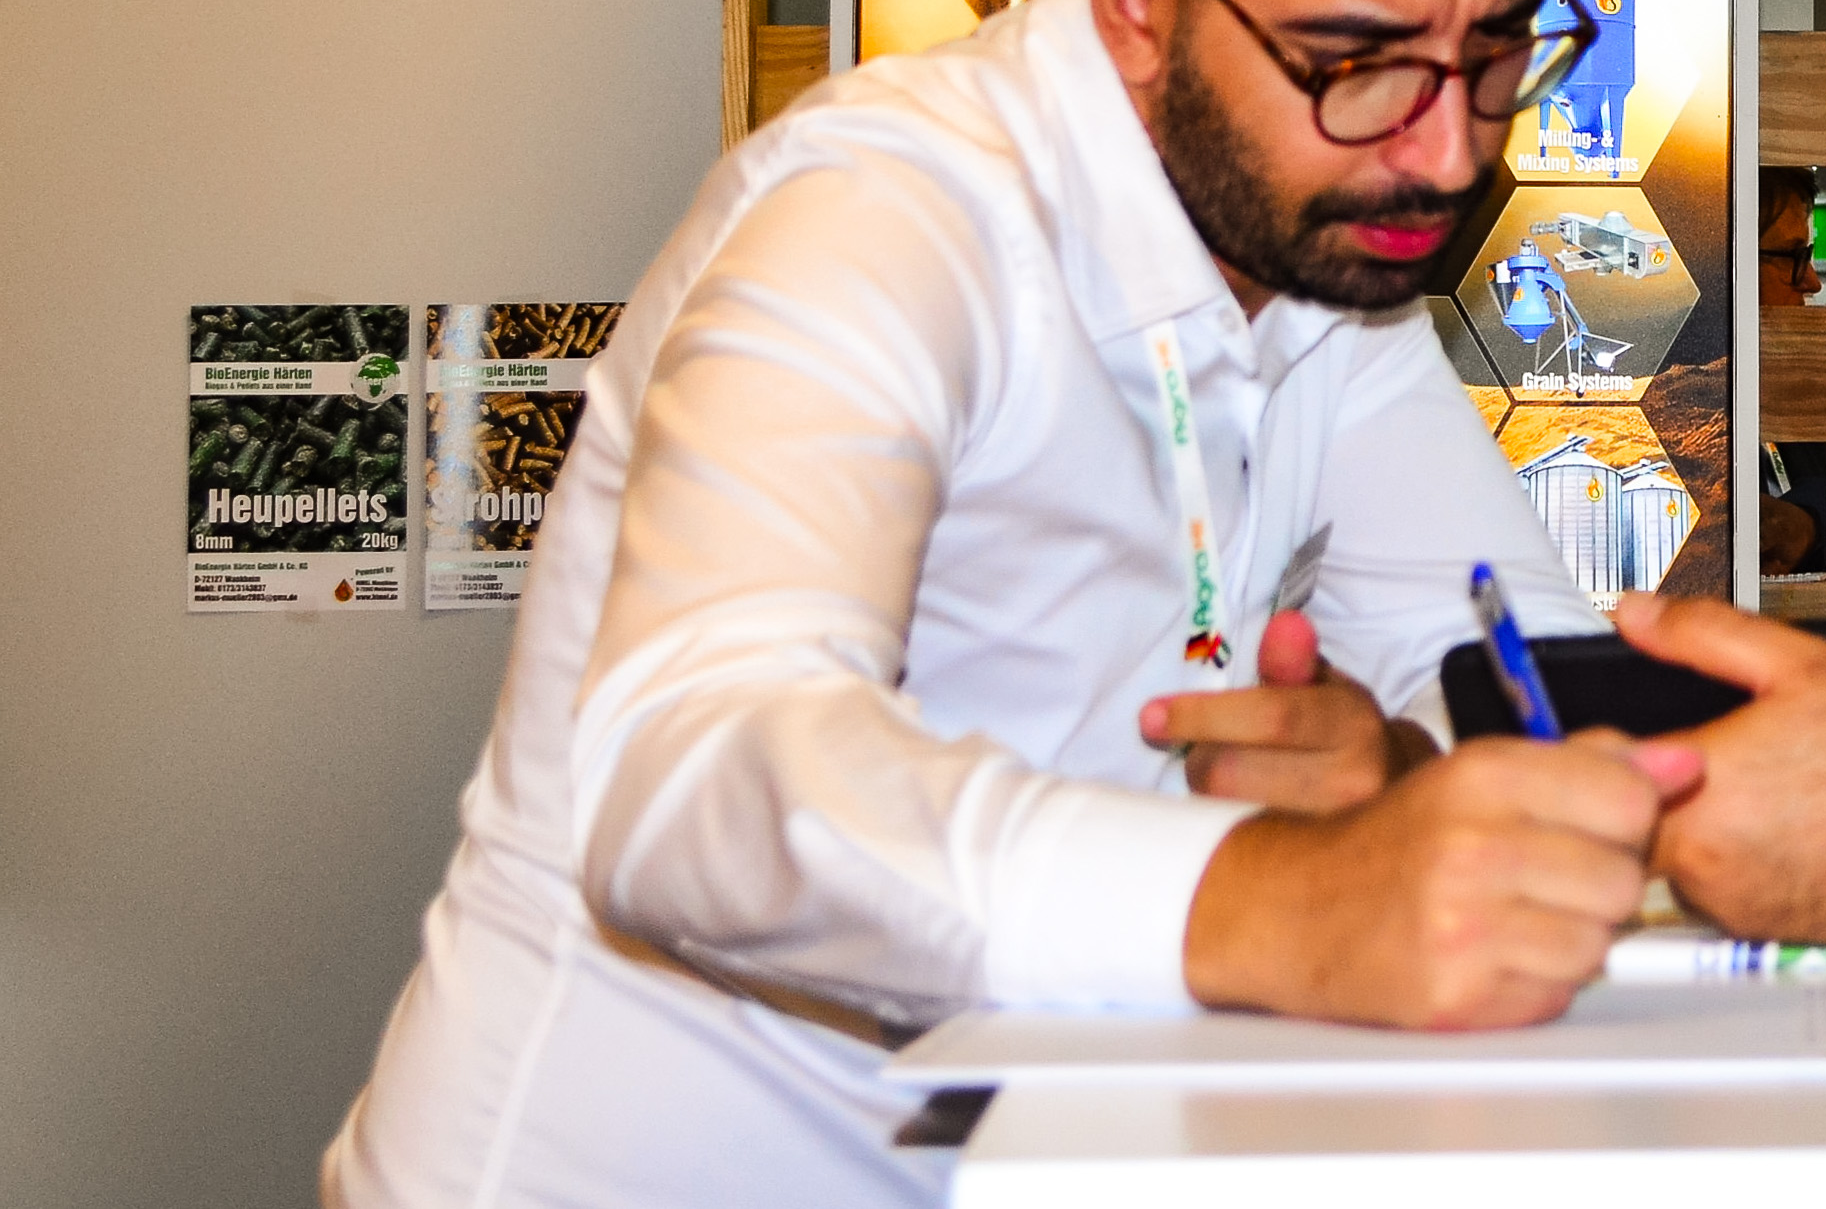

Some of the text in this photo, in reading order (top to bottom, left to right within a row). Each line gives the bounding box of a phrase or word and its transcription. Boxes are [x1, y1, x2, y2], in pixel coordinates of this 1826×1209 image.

[1539, 129, 1615, 150] Milling- &
[1517, 153, 1639, 174] Mixing Systems
[205, 366, 312, 381] BioEnergie Härten
[508, 363, 548, 377] Härten
[1522, 372, 1634, 395] Grain Systems
[208, 488, 389, 528] Heupellets
[195, 533, 234, 550] 8mm
[361, 532, 399, 551] 20kg
